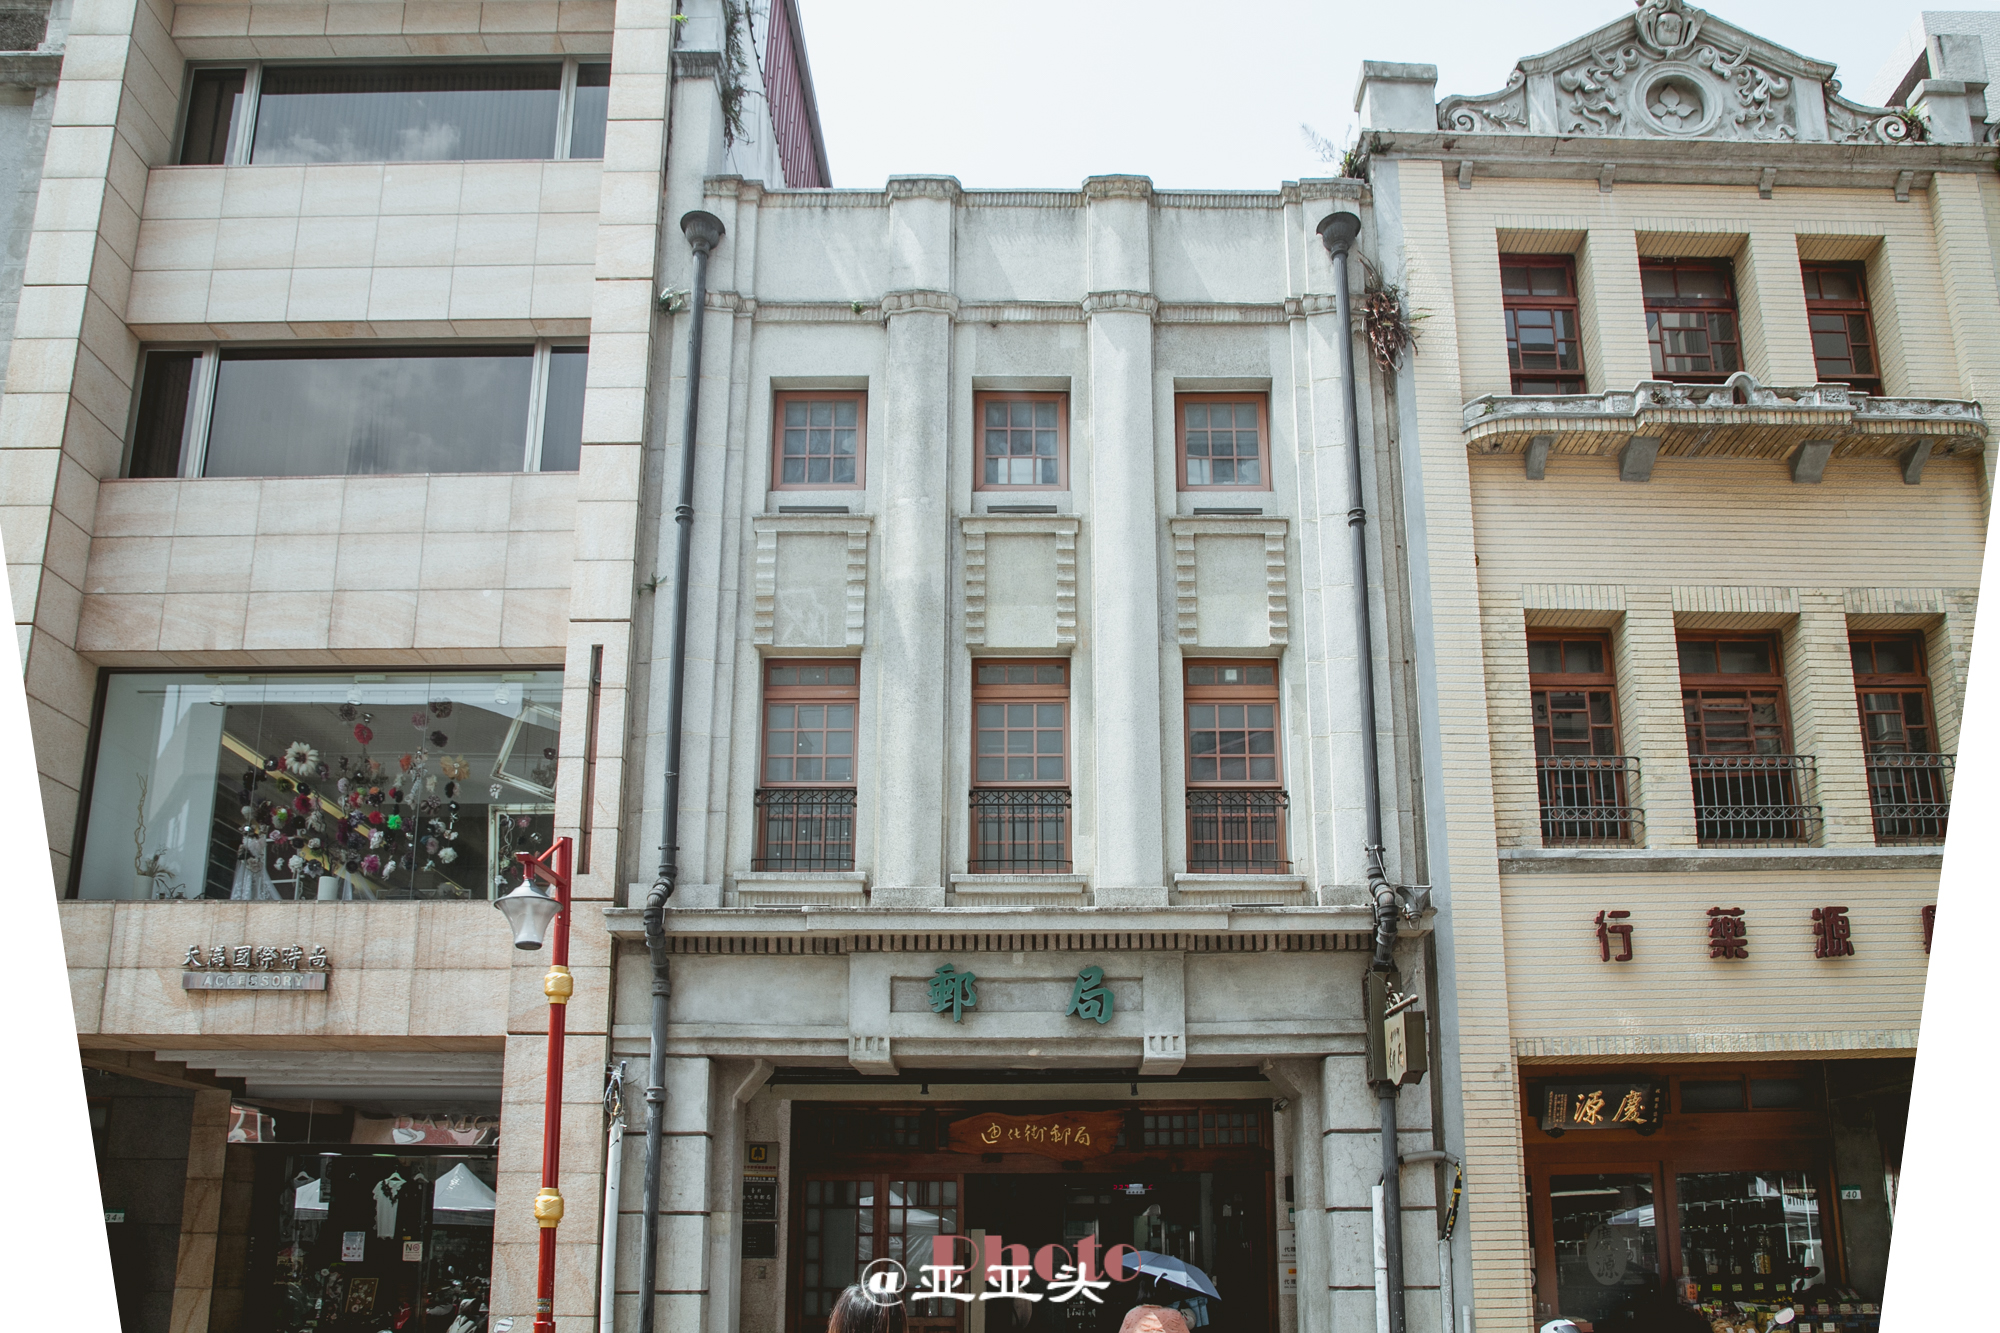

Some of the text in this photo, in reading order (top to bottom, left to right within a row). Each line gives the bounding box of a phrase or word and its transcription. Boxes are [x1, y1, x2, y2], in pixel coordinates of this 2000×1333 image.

[202, 975, 304, 988] ACCESSORY
[928, 963, 1115, 1024] 郵局
[1845, 1190, 1858, 1199] 40
